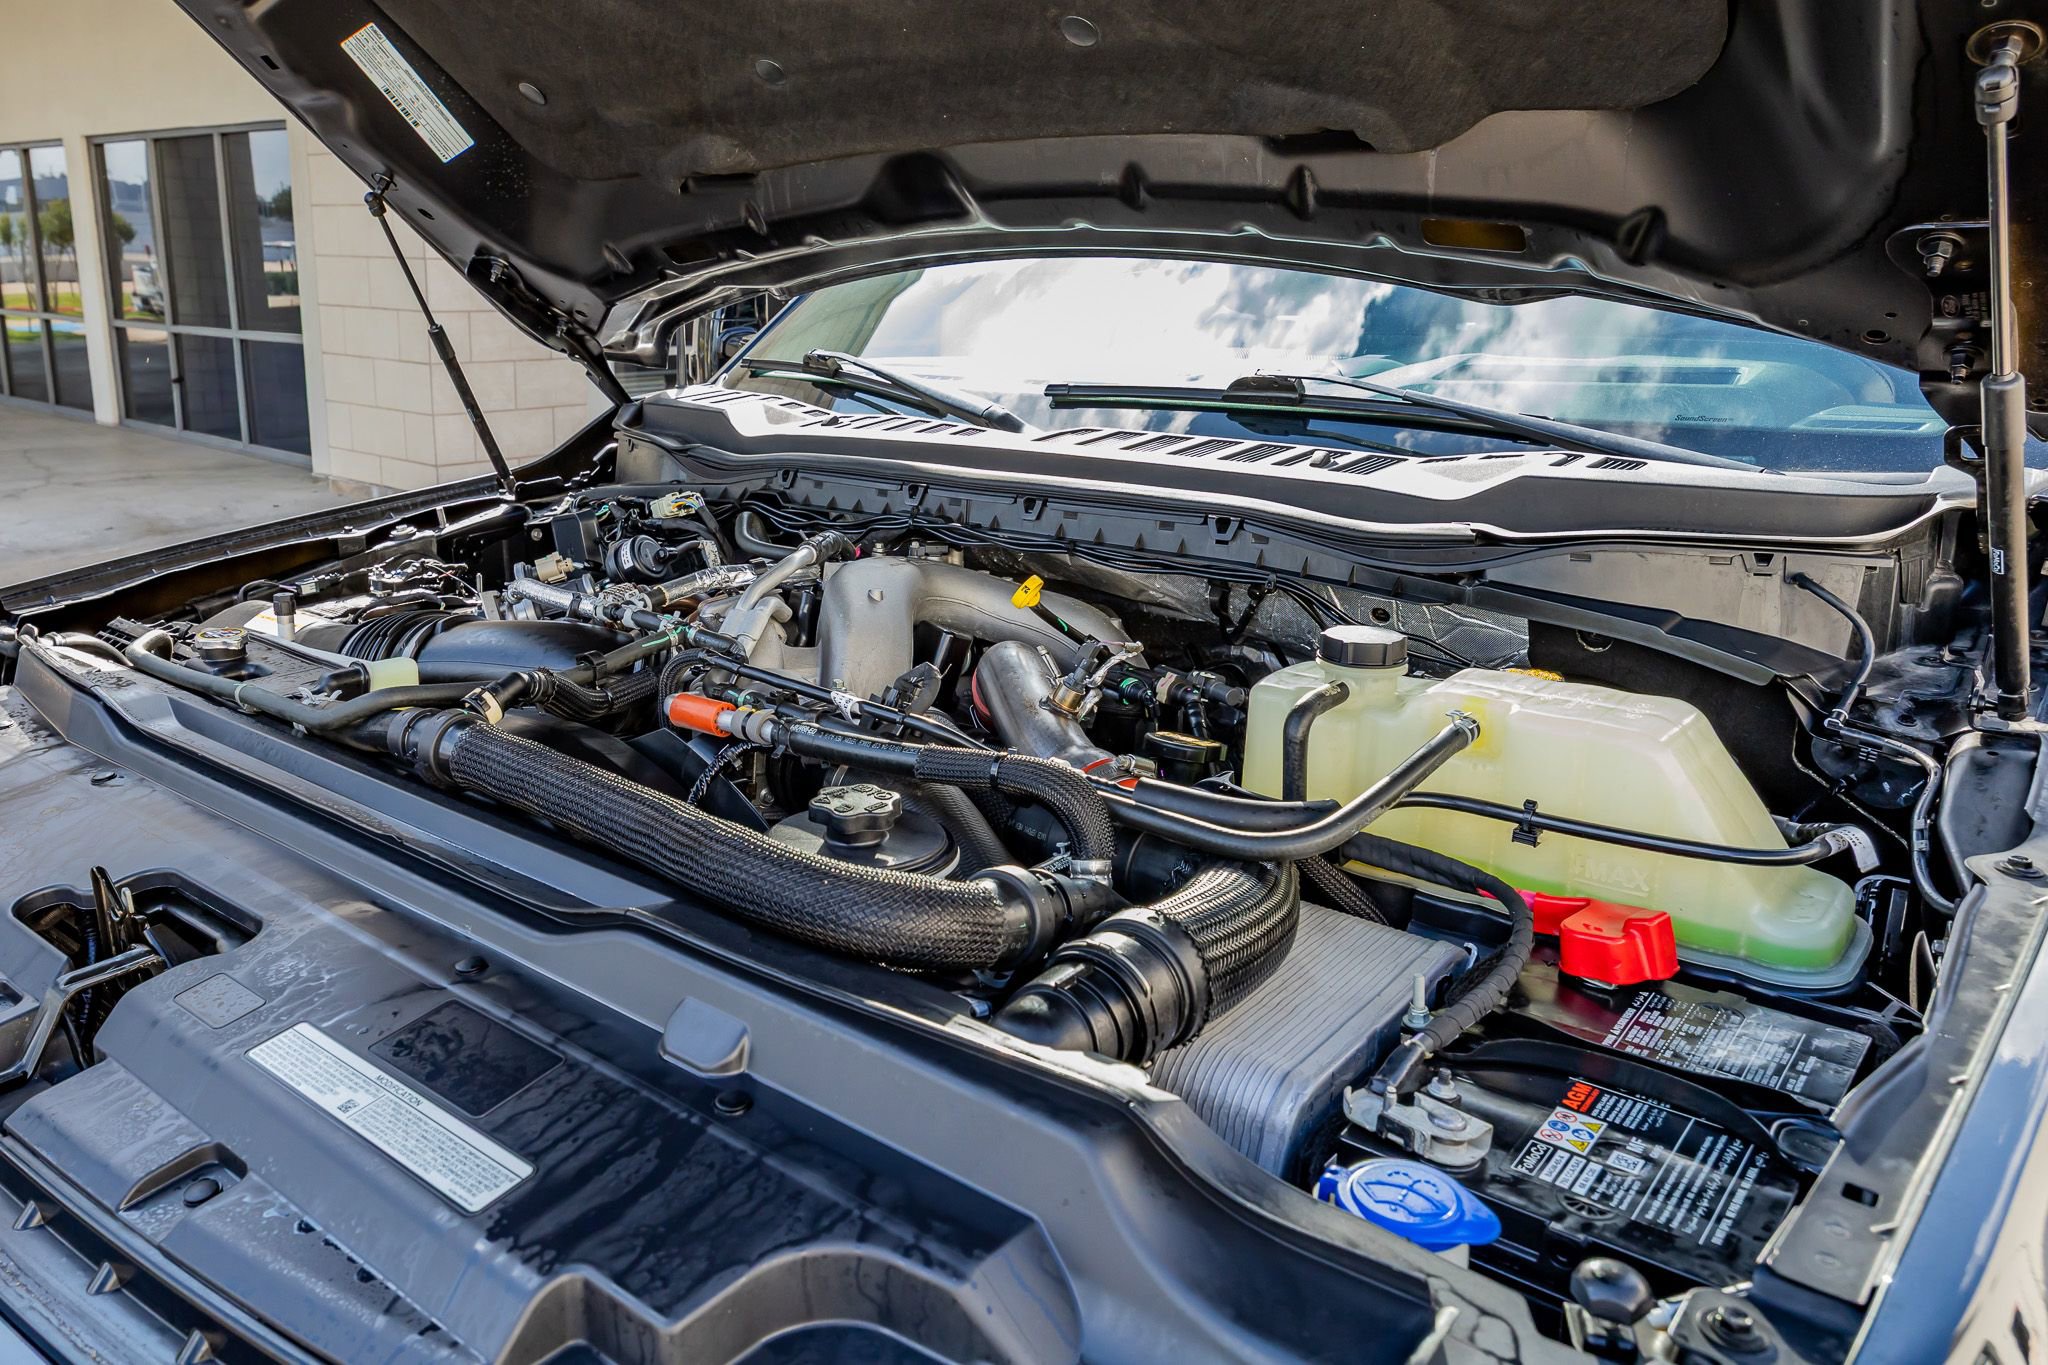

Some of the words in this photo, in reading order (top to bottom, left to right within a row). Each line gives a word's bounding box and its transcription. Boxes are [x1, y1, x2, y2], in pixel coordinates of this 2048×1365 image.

[1674, 414, 1728, 423] SoundScreen
[376, 1074, 424, 1107] MODIFICATION
[1562, 1081, 1593, 1110] AGM
[1517, 1143, 1548, 1174] FoMoCo
